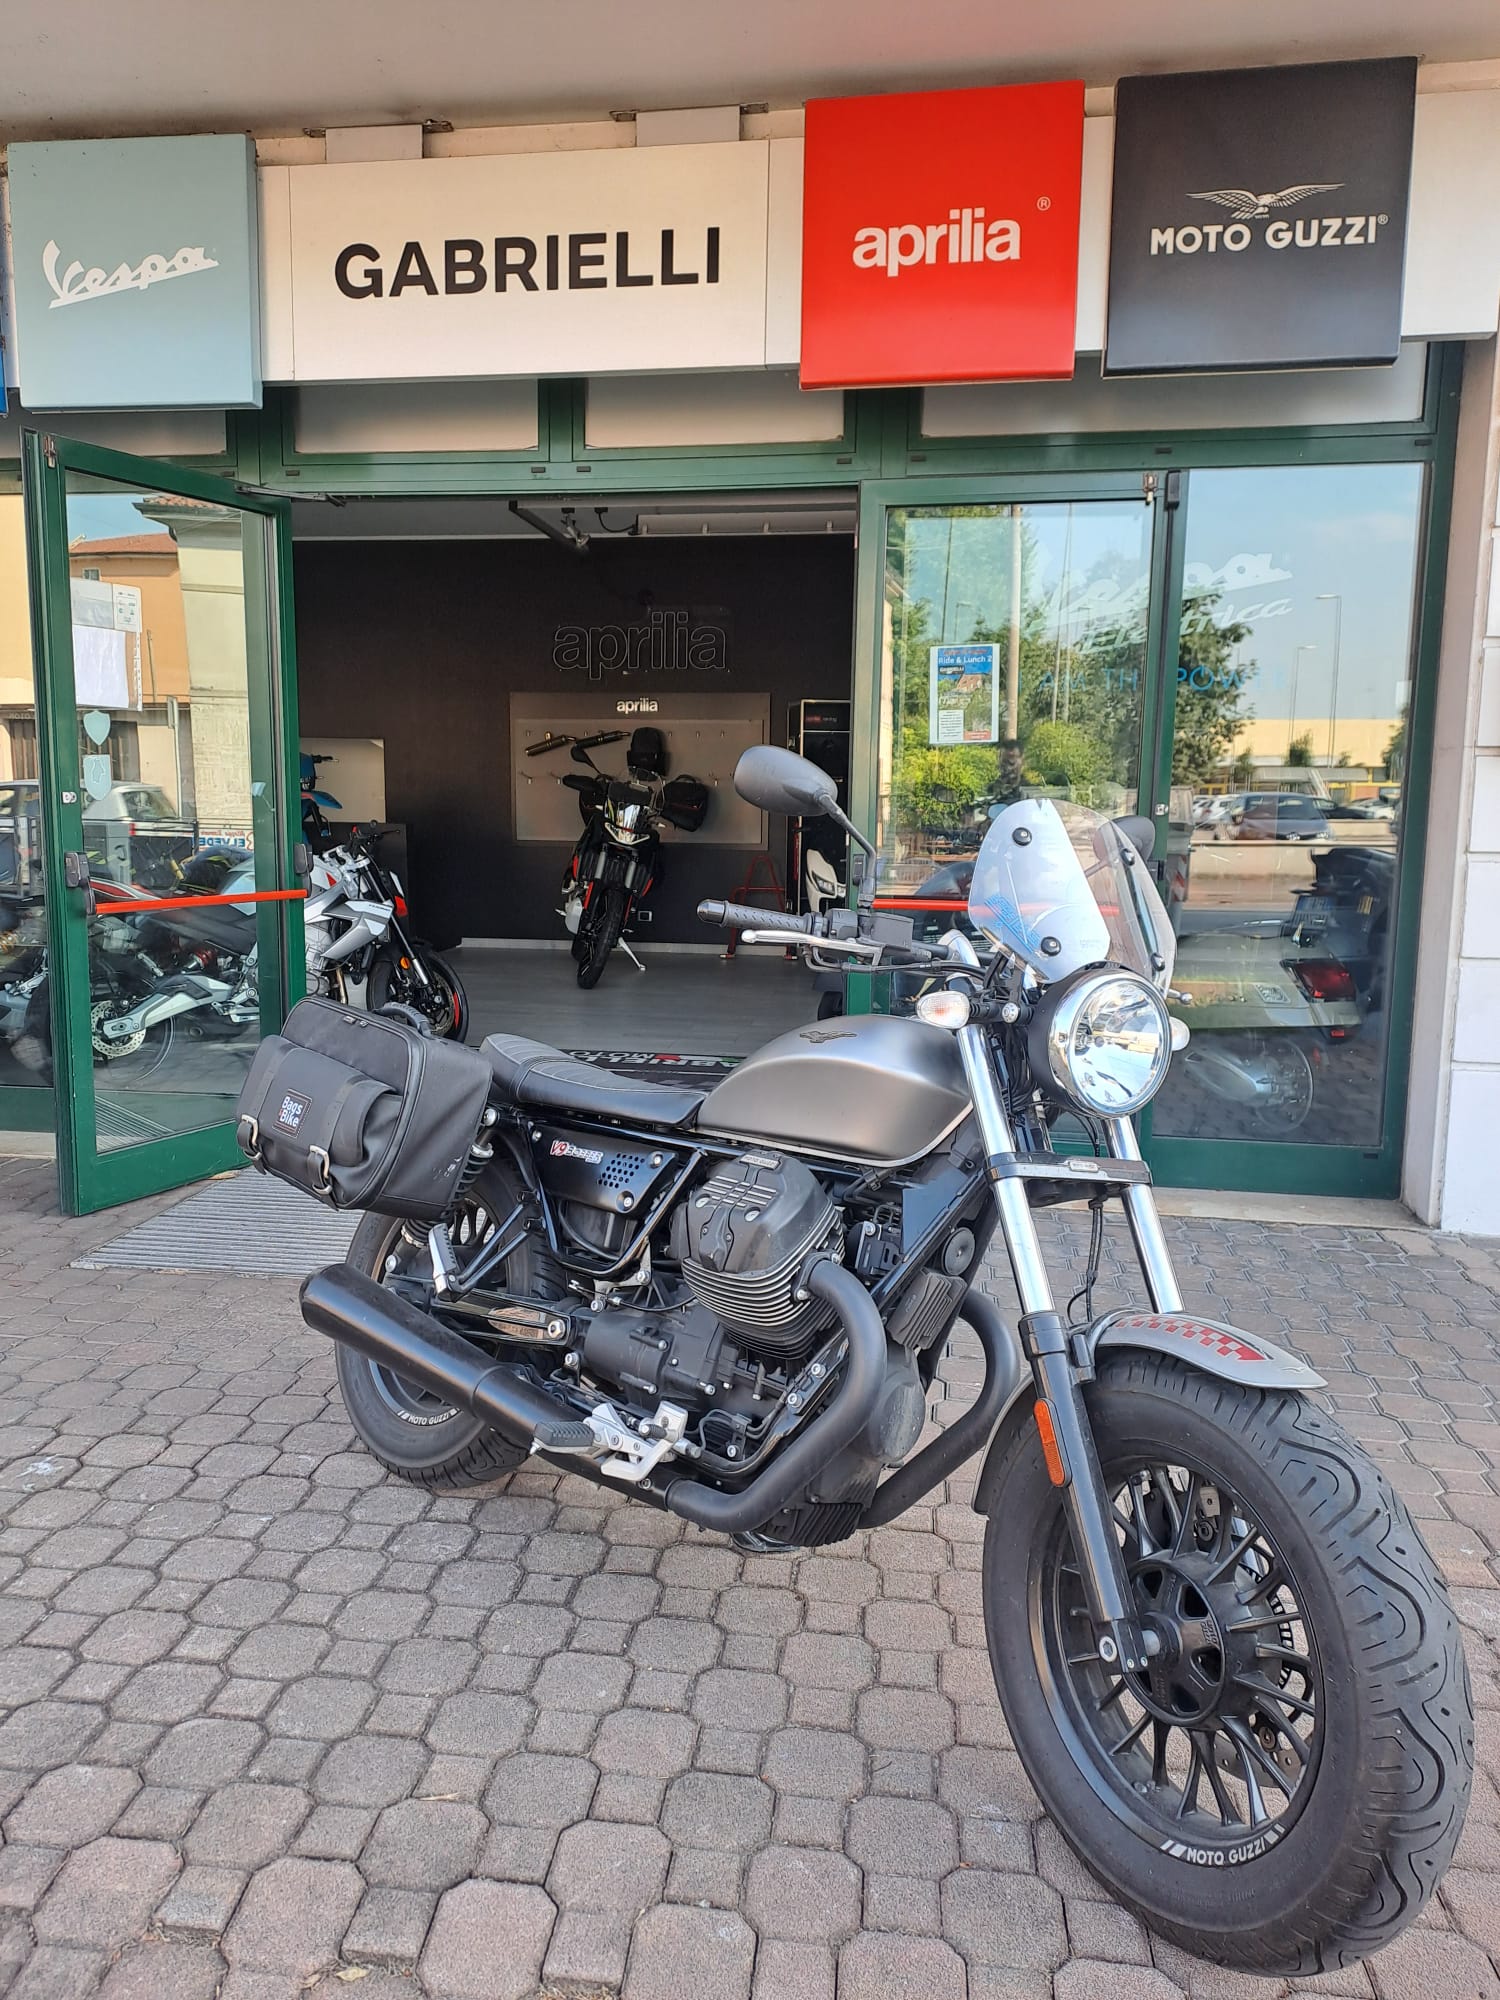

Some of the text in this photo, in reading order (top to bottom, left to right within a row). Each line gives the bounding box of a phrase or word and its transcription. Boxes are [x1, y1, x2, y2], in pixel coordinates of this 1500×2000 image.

[852, 207, 1021, 277] aprilia
[1150, 215, 1377, 255] MOTO GUZZI
[41, 239, 219, 309] Vespa
[334, 226, 720, 300] GABRIELLI
[552, 611, 726, 680] aprilia
[963, 654, 986, 663] Lunch
[616, 698, 658, 715] aprilia
[282, 1096, 303, 1115] Bags
[279, 1109, 299, 1127] Bike
[550, 1140, 569, 1156] V9
[408, 1412, 449, 1425] MOTO GUZZI
[1186, 1837, 1265, 1866] MOTO GUZZI
